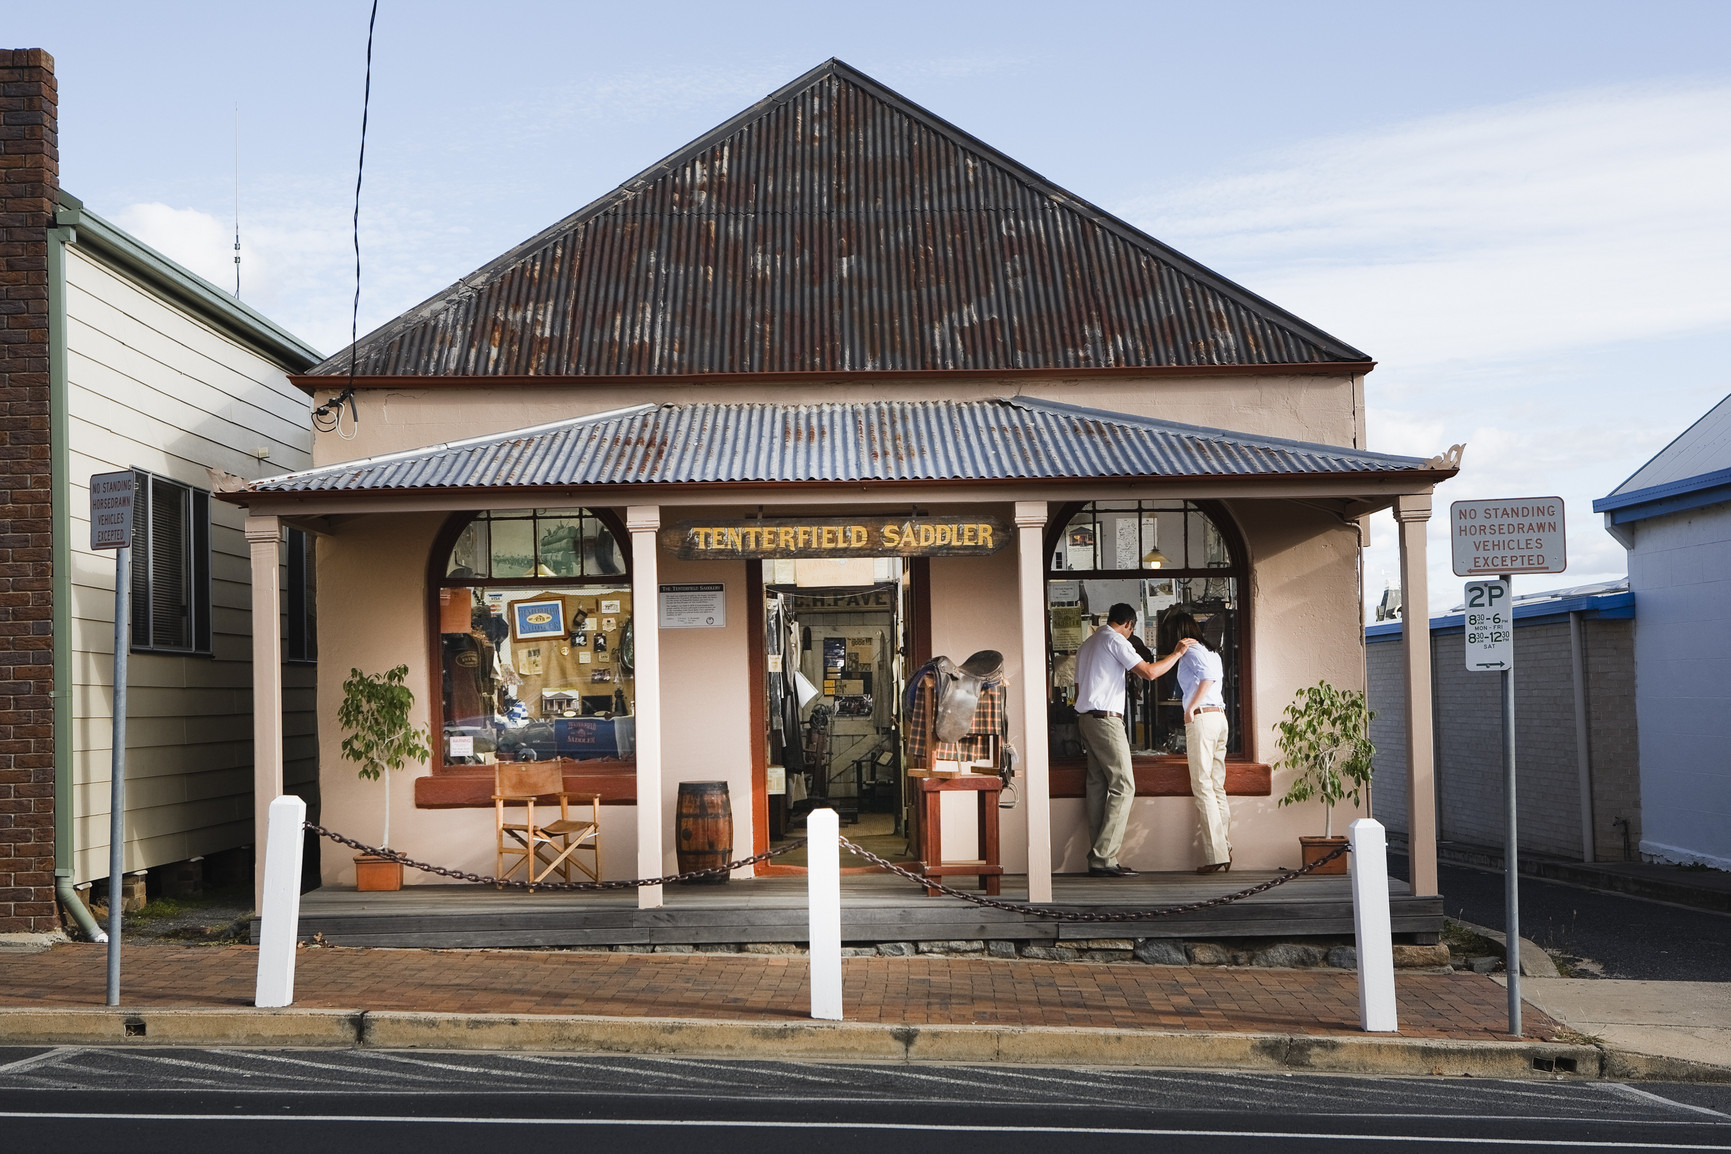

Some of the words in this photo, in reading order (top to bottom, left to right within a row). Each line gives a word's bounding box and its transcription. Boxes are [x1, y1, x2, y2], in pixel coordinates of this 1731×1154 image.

[93, 483, 100, 494] NO
[102, 480, 131, 493] STANDING
[93, 496, 131, 510] HORSEDRAWN
[98, 513, 124, 525] VEHICLES
[1458, 509, 1477, 520] NO
[1484, 505, 1556, 519] STANDING
[97, 529, 124, 541] EXCEPTED
[1459, 521, 1557, 536] HORSEDRAWN
[691, 525, 868, 551] TENTERFIELD
[880, 521, 993, 549] SADDLER
[1473, 538, 1543, 551] VEHICLES
[1473, 554, 1545, 567] EXCEPTED
[1468, 585, 1505, 608] 2P
[1492, 613, 1501, 624] 6
